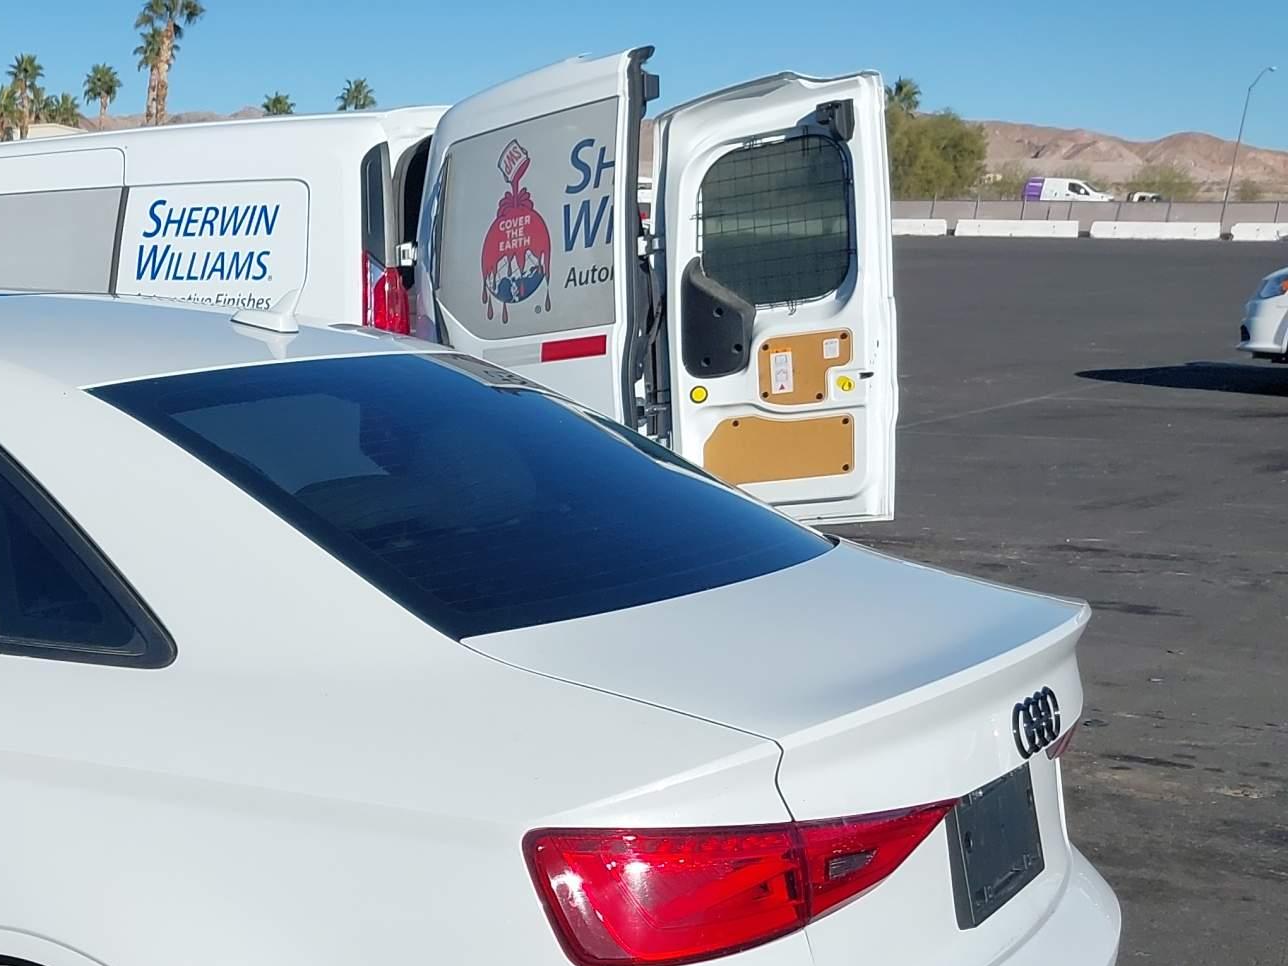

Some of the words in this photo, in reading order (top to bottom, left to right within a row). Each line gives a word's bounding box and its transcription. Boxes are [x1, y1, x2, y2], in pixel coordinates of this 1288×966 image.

[142, 199, 280, 239] SHERWIN
[498, 215, 531, 231] COVER
[506, 227, 524, 239] THE
[499, 236, 531, 251] EARTH
[135, 244, 271, 281] WILLIAMS
[564, 264, 614, 288] Auto
[215, 292, 272, 310] Finishes
